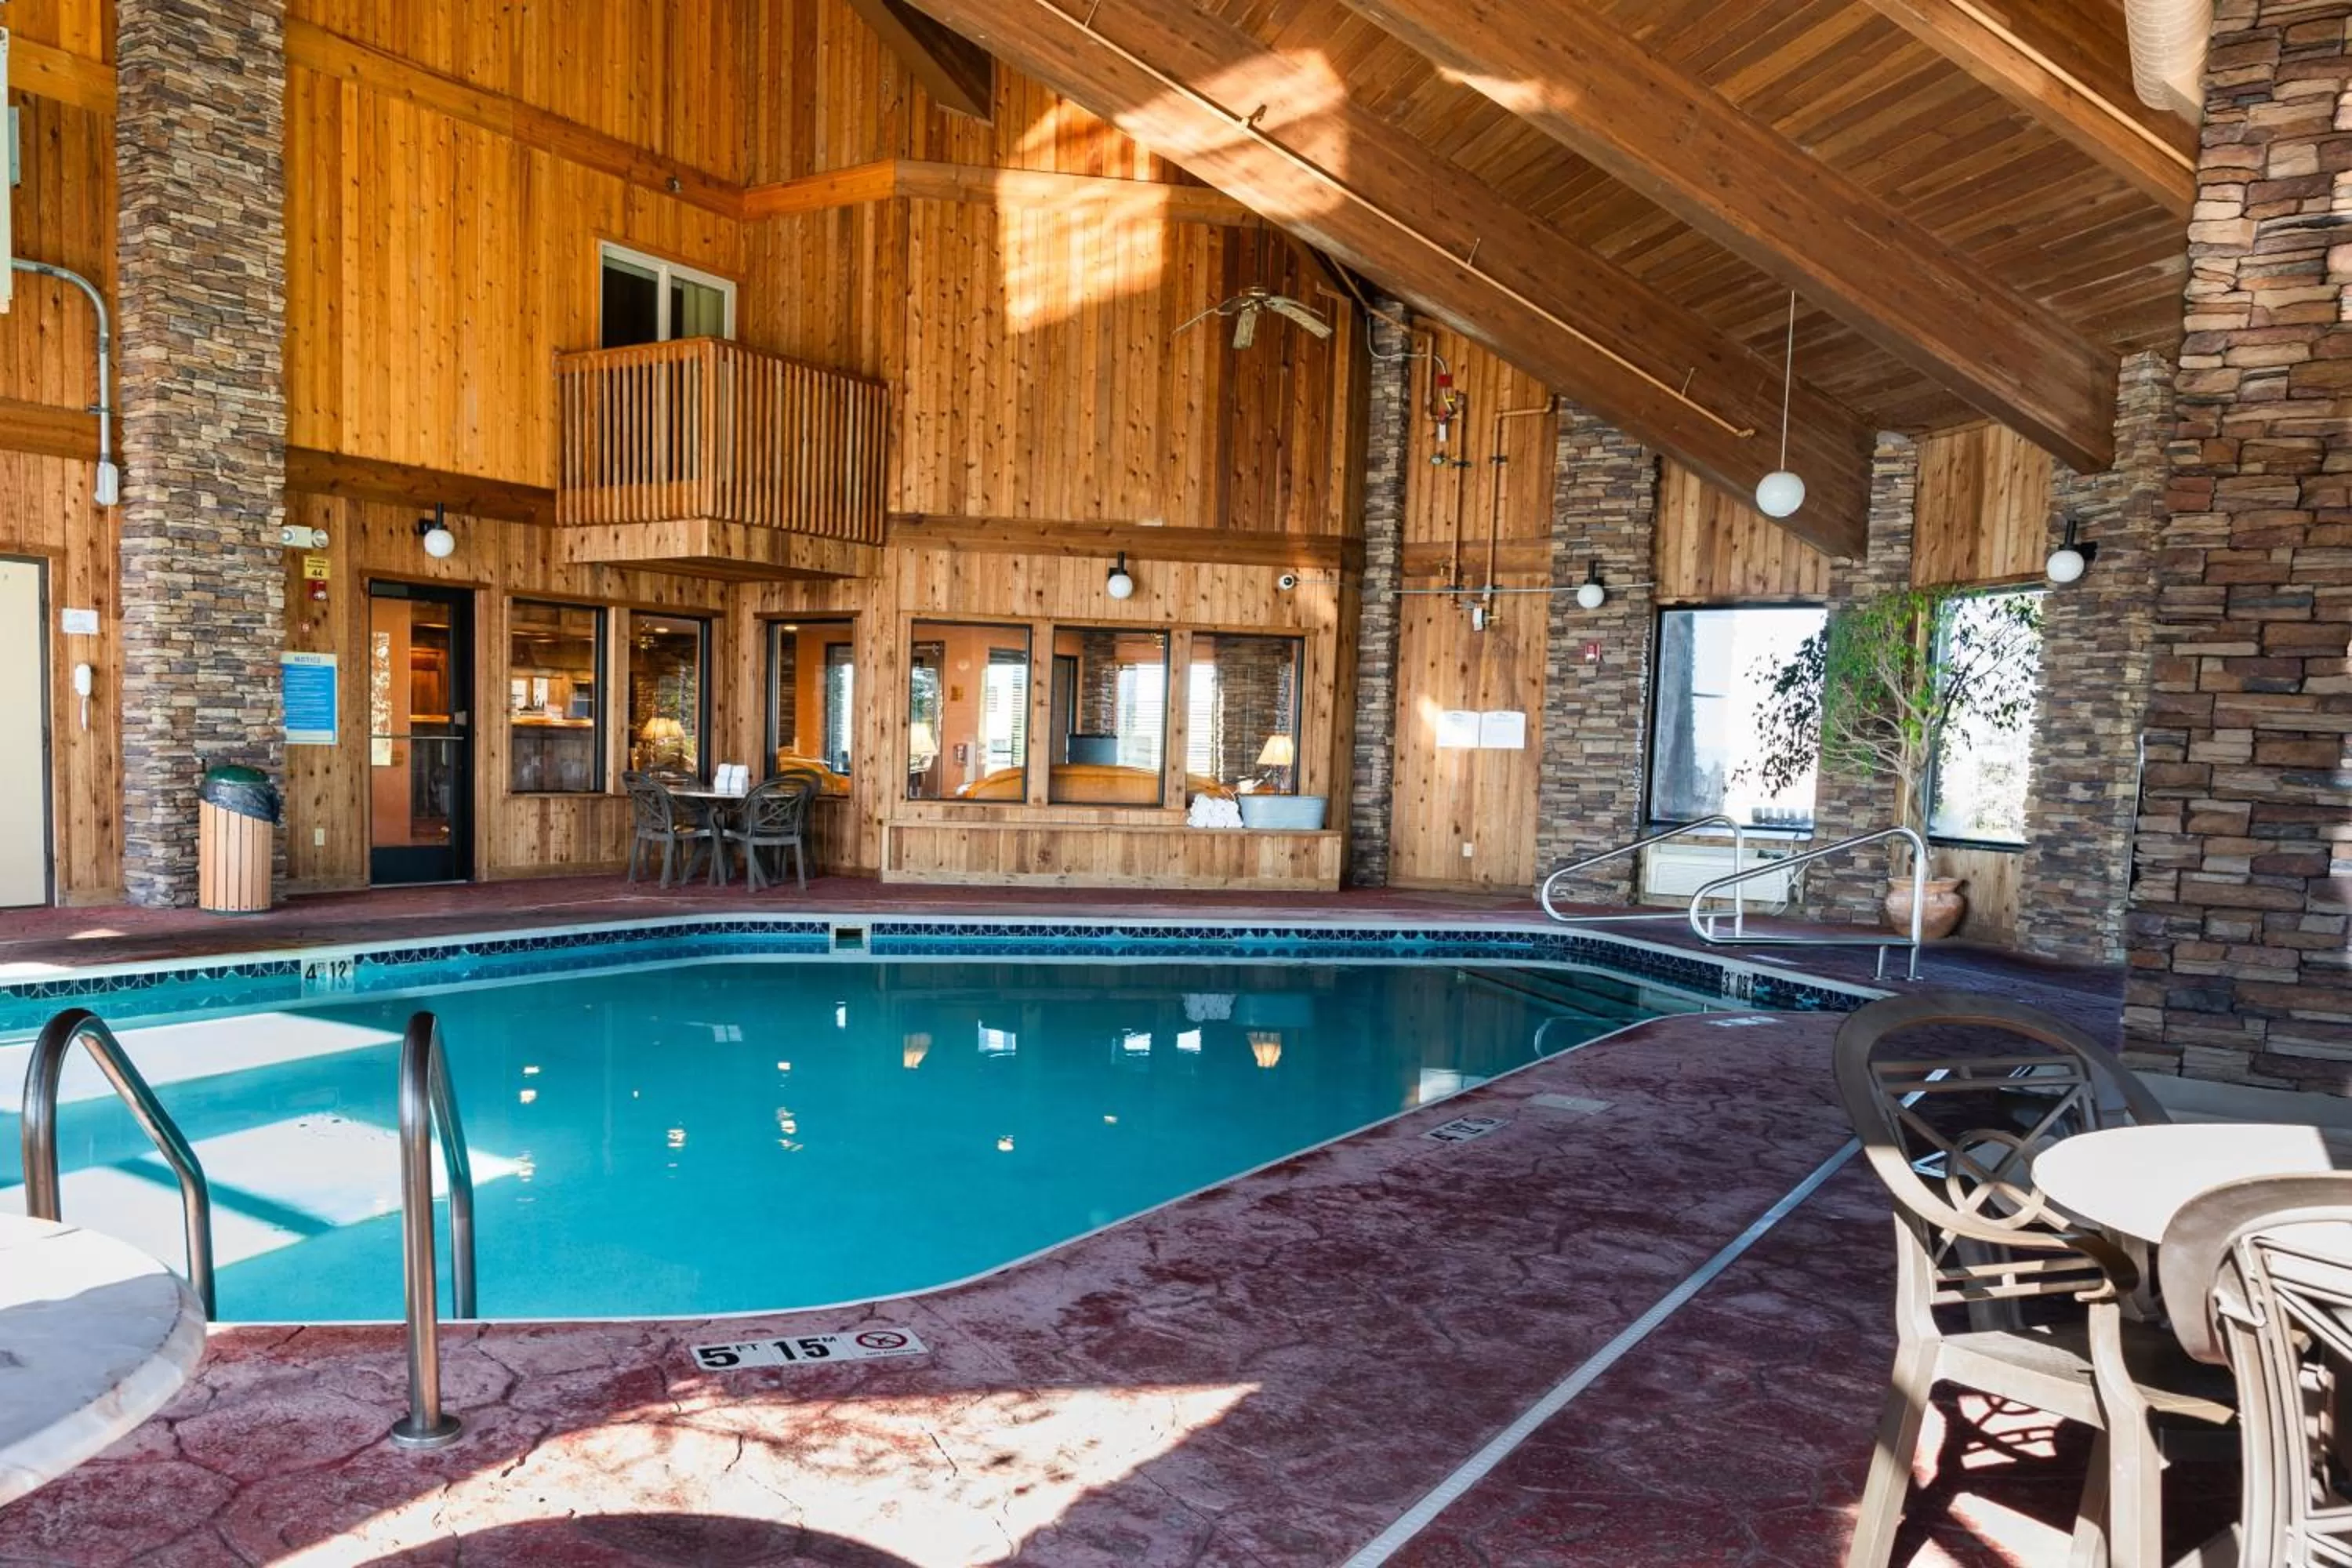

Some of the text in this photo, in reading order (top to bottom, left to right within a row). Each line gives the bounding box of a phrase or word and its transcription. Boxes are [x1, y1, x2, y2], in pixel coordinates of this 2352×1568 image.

[311, 568, 323, 577] 44
[305, 962, 317, 979] 4
[698, 1346, 740, 1367] 5
